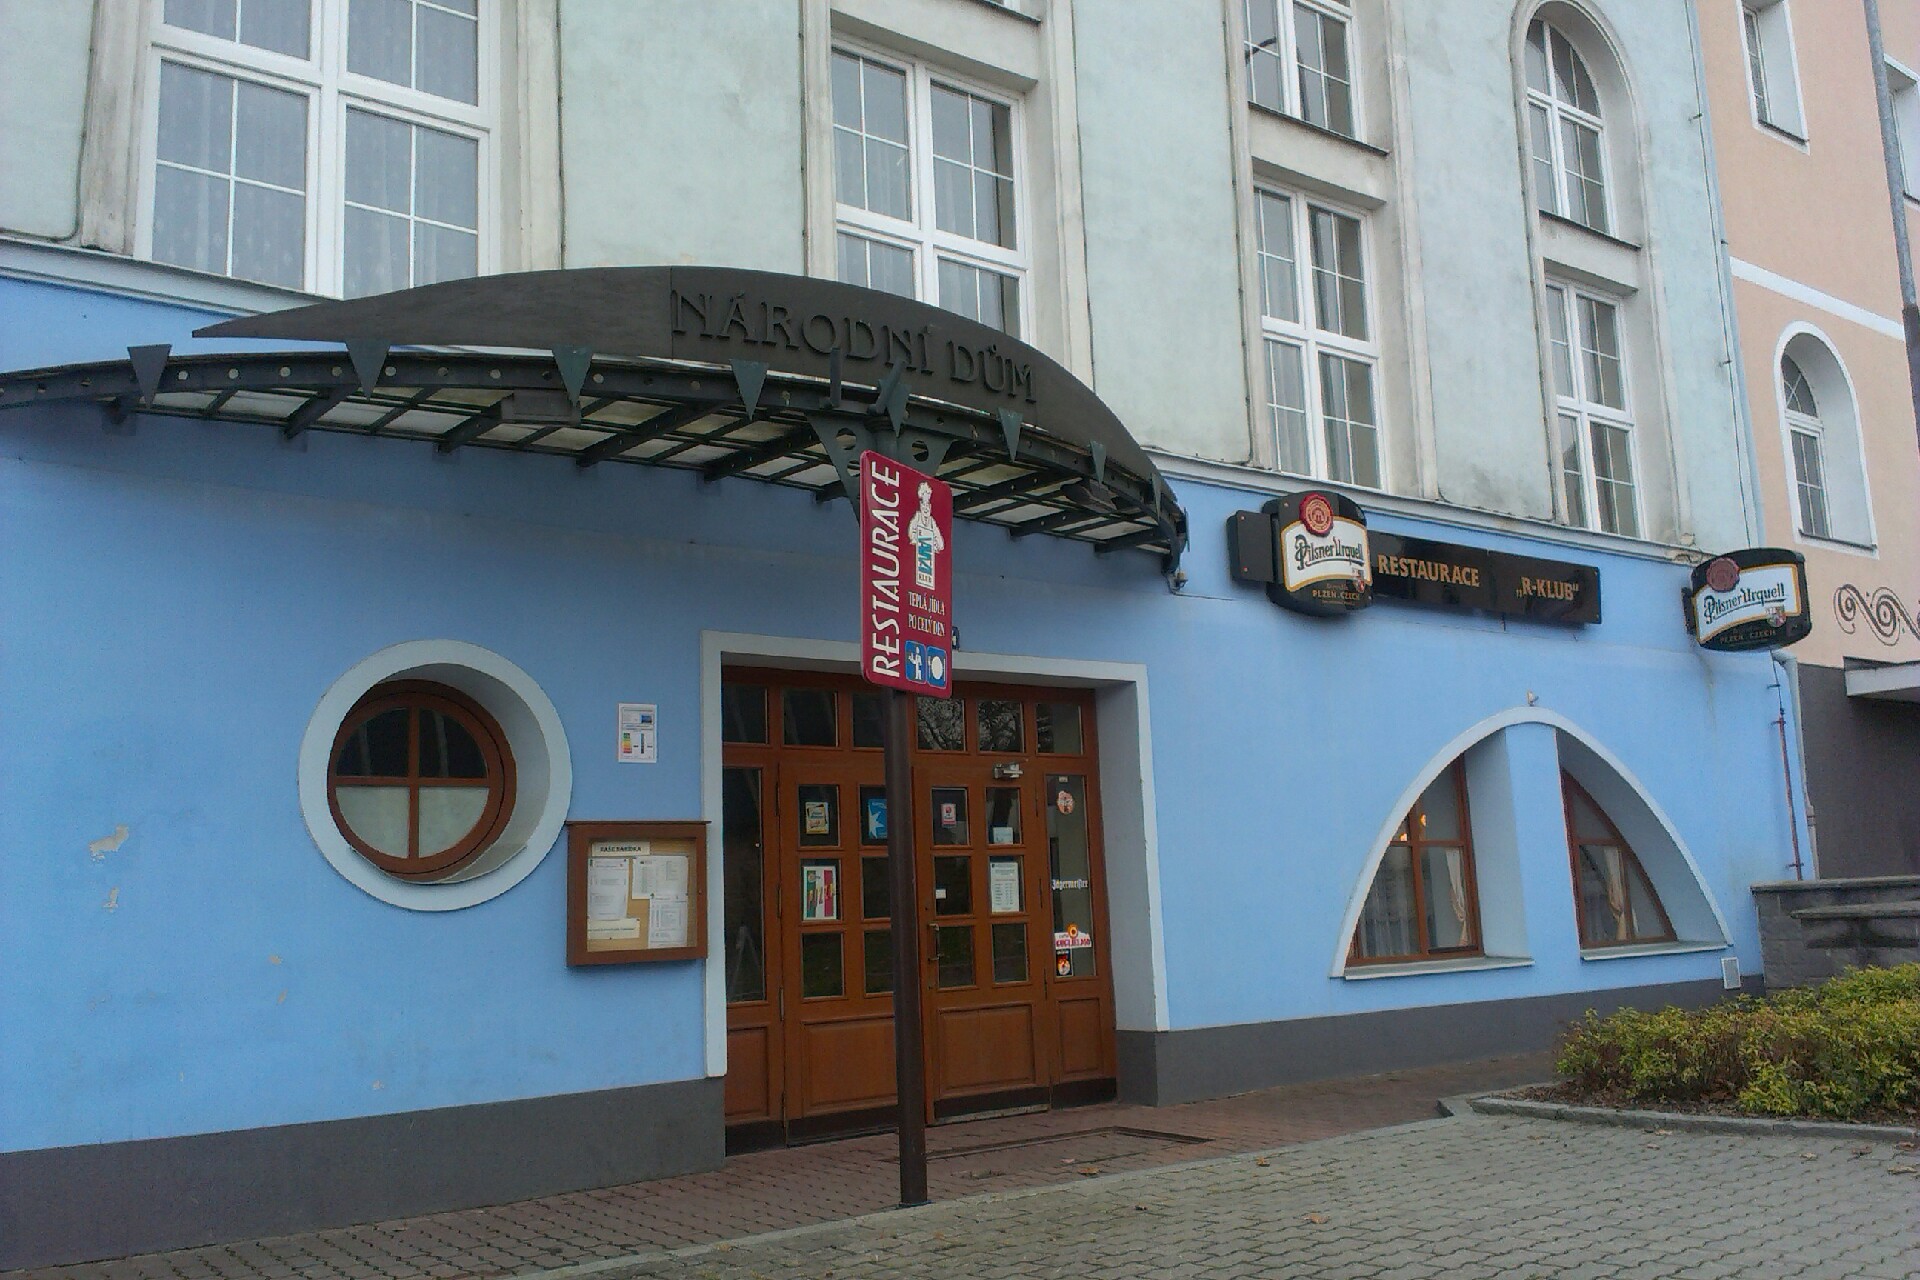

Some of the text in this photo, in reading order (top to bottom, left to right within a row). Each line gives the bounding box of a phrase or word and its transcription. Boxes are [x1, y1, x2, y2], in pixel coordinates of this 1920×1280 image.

[671, 289, 1037, 404] NÁRODNÍ DŮM
[871, 461, 900, 678] RESTAURACE
[1294, 534, 1364, 571] Pilsner Urquell
[1377, 554, 1480, 588] RESTAURACE
[908, 613, 917, 629] PO
[928, 595, 945, 615] JÍDLA
[1704, 582, 1785, 624] Pilsner Urquell
